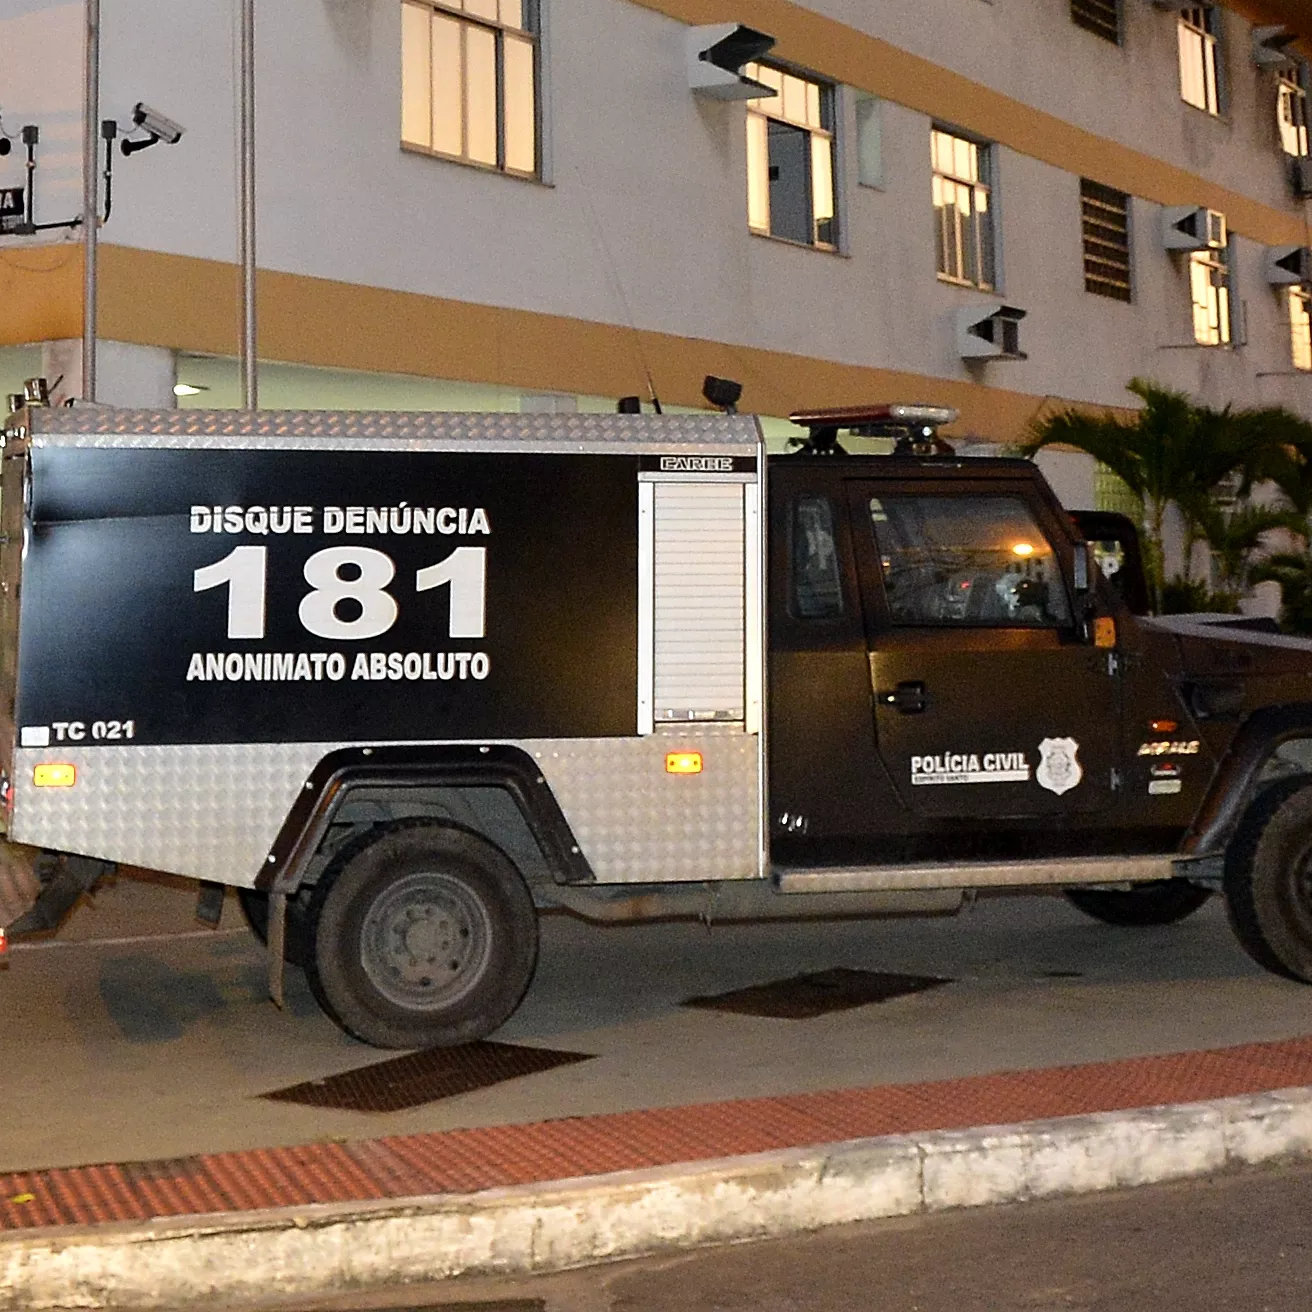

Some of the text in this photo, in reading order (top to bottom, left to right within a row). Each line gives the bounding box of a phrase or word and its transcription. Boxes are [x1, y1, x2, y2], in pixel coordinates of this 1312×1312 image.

[190, 501, 491, 536] DISQUE DENÚNCIA
[193, 545, 487, 639] 181
[186, 652, 490, 681] ANONIMATO ABSOLUTO
[52, 720, 135, 740] TC 021
[911, 751, 1029, 773] POLÍCIA CIVIL
